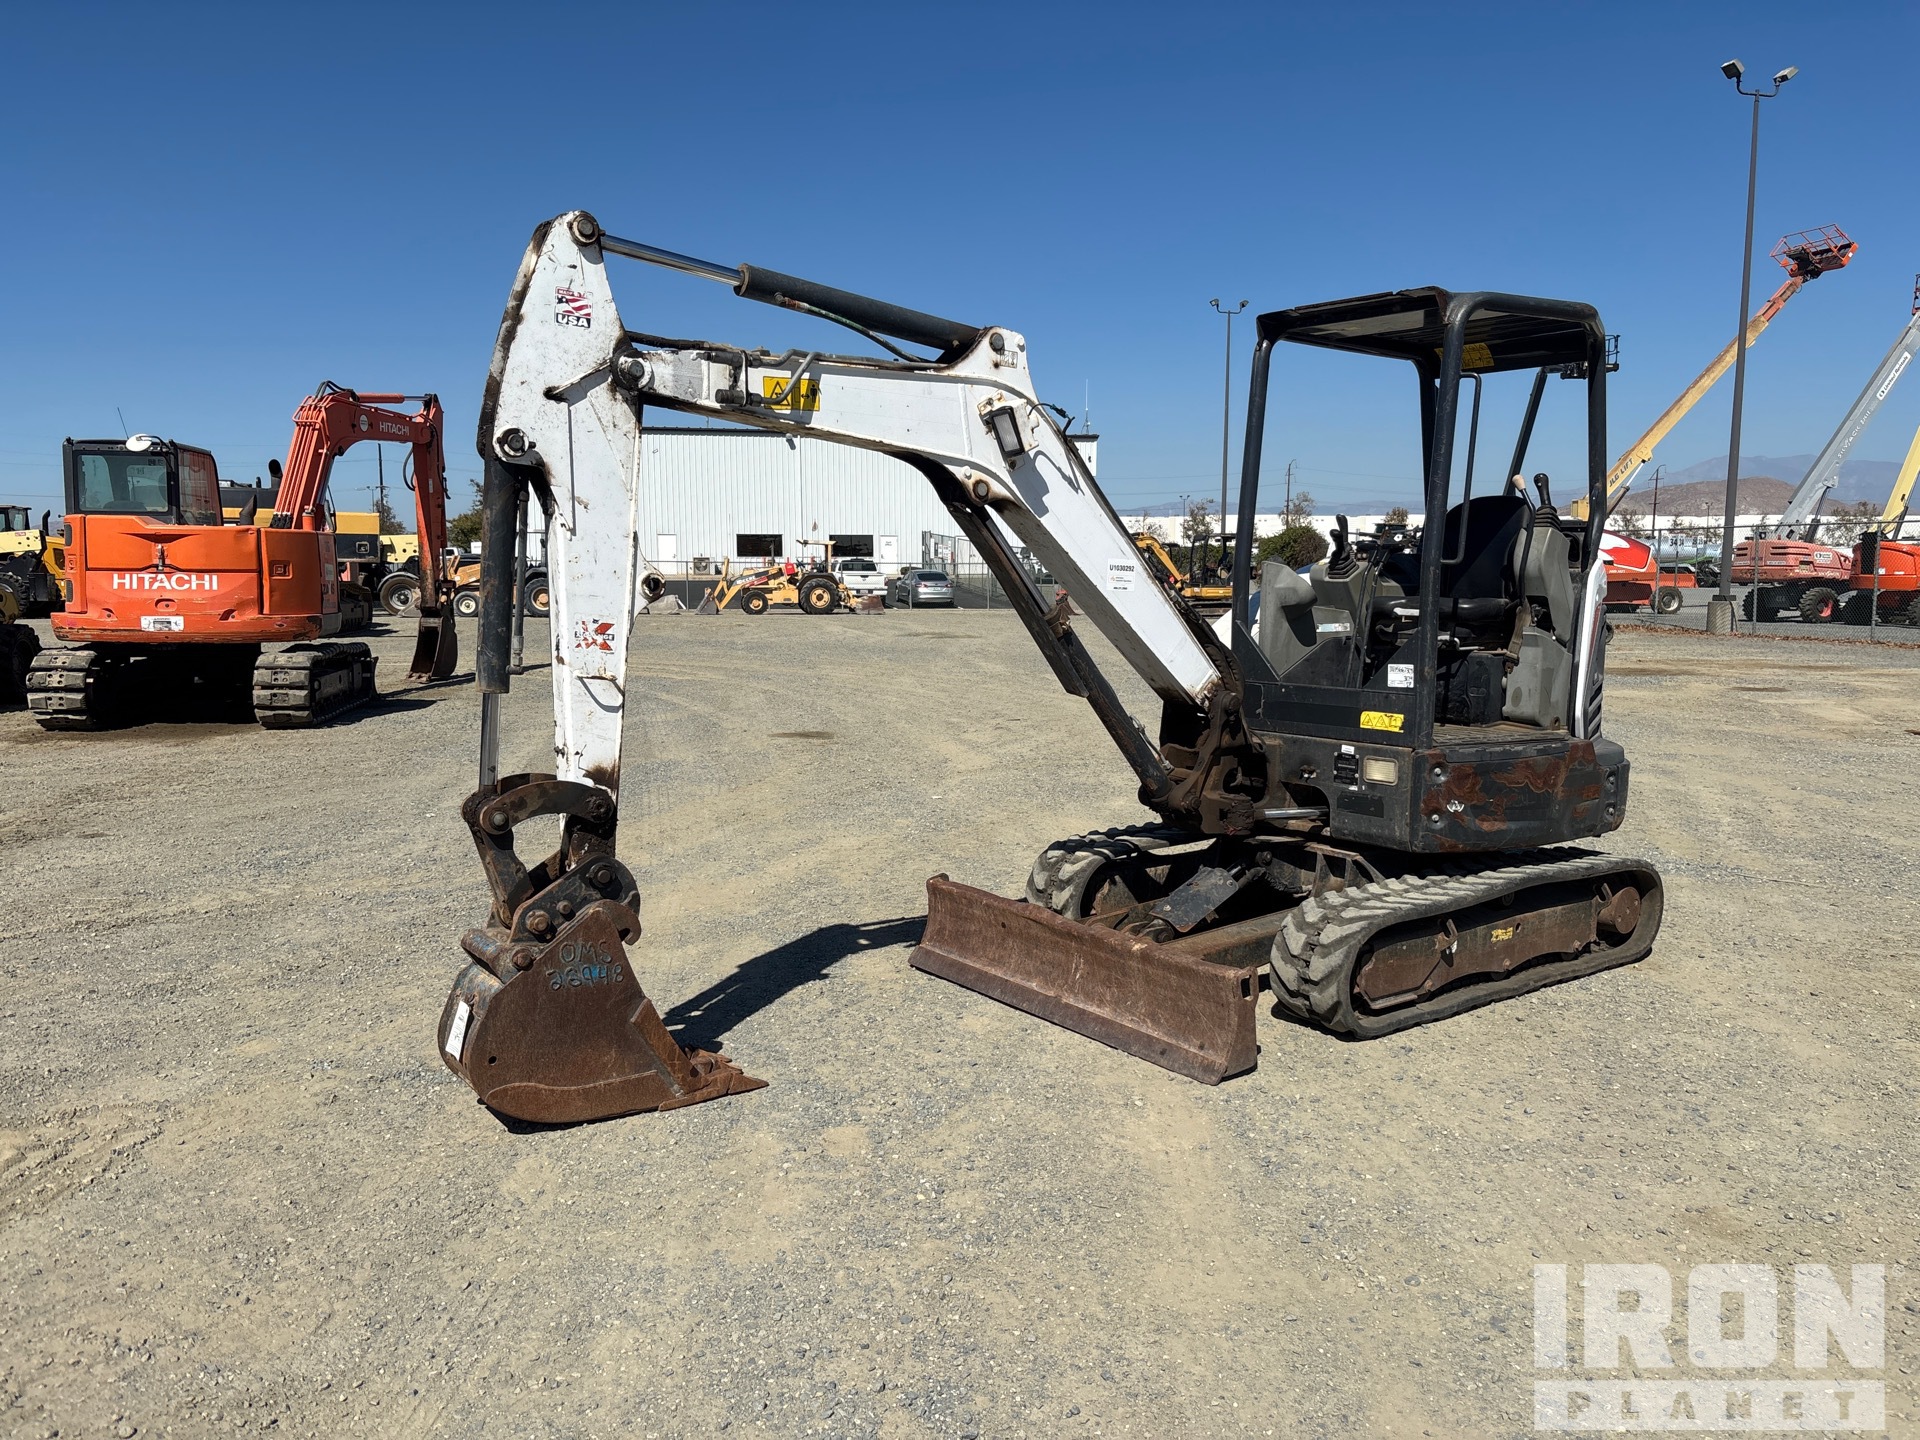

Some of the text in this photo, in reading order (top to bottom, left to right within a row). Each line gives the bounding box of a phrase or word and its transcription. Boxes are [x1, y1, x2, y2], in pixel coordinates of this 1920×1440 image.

[557, 314, 590, 328] USA
[1895, 355, 1909, 375] Rentals
[379, 421, 410, 436] HITACHI
[1609, 457, 1633, 488] JLG LIFT
[112, 573, 219, 591] HITACHI
[560, 940, 612, 963] OMS
